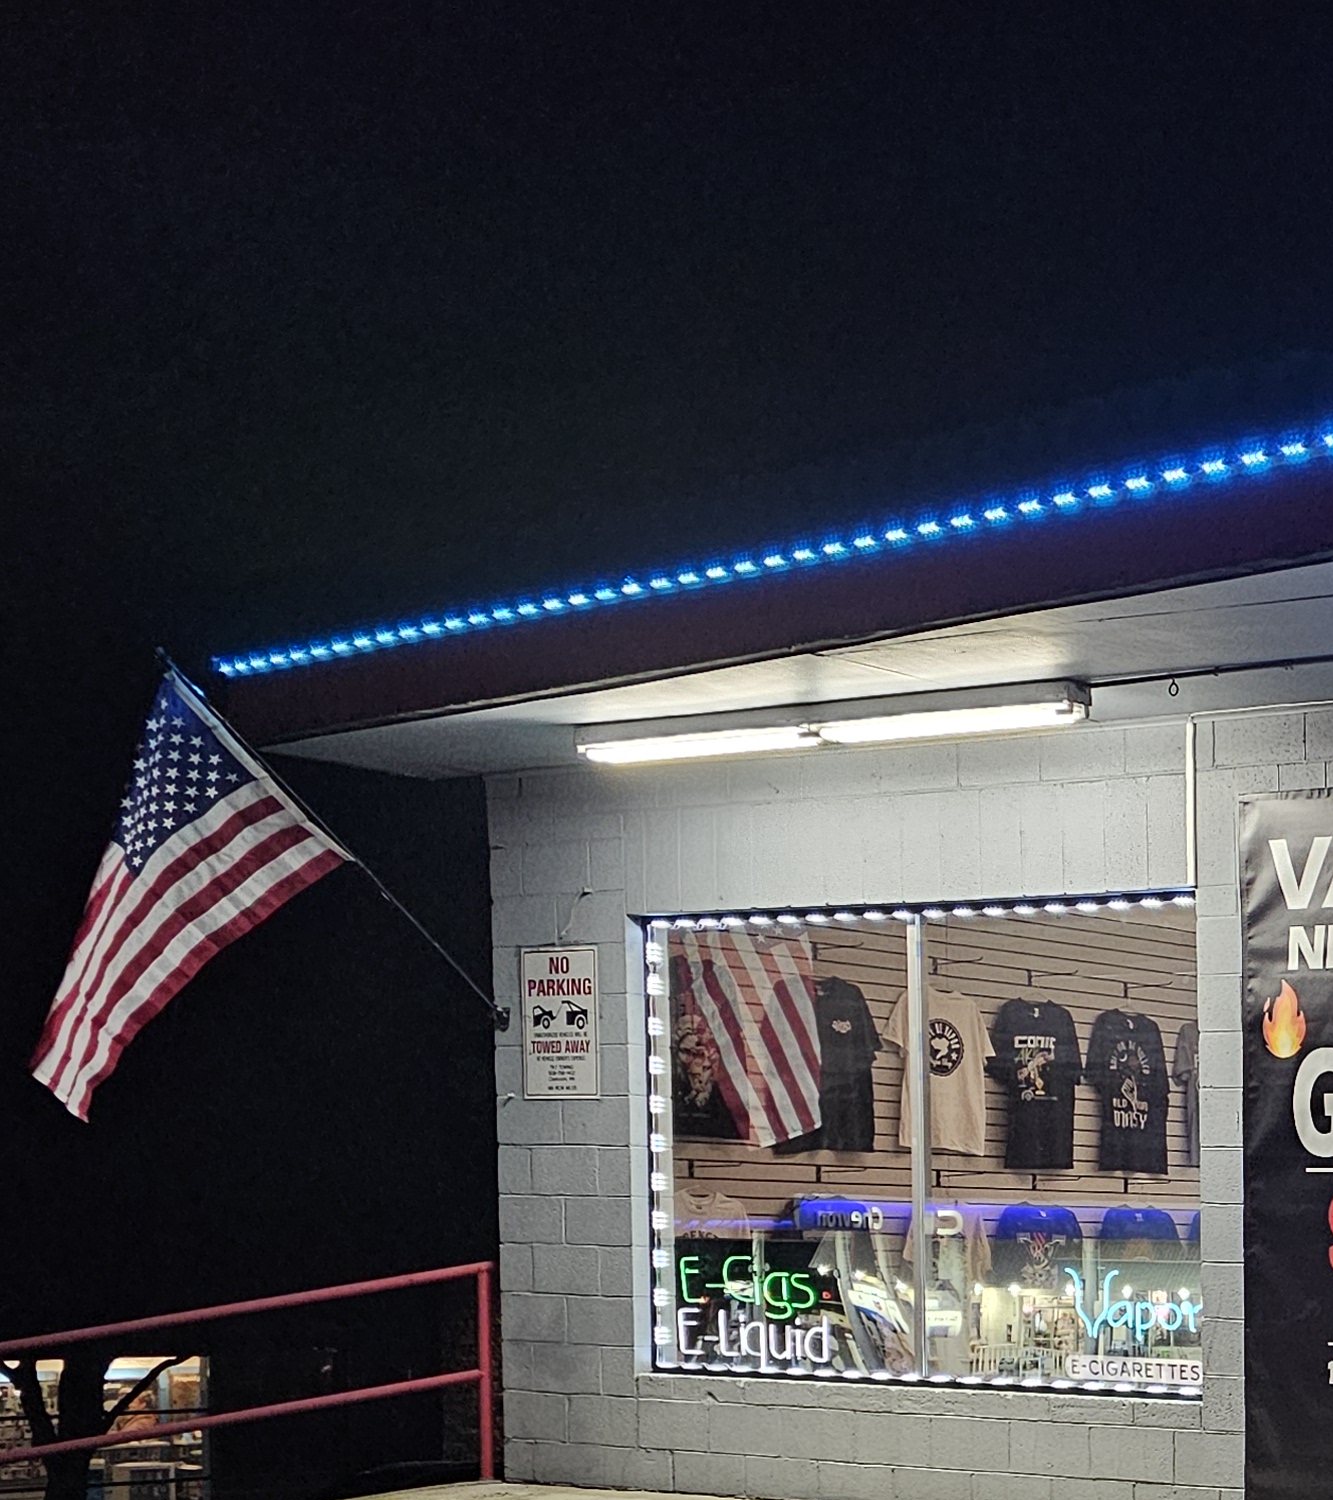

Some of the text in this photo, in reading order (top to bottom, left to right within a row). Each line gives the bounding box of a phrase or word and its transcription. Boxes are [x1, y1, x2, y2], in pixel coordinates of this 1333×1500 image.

[549, 955, 569, 974] NO
[528, 977, 592, 997] PARKING
[531, 1040, 590, 1054] TOWED AWAY
[680, 1256, 815, 1320] E-Cigs
[1064, 1267, 1203, 1341] Vapor
[678, 1308, 830, 1371] E-Liquid
[1071, 1359, 1200, 1381] E-CIGARETTES
